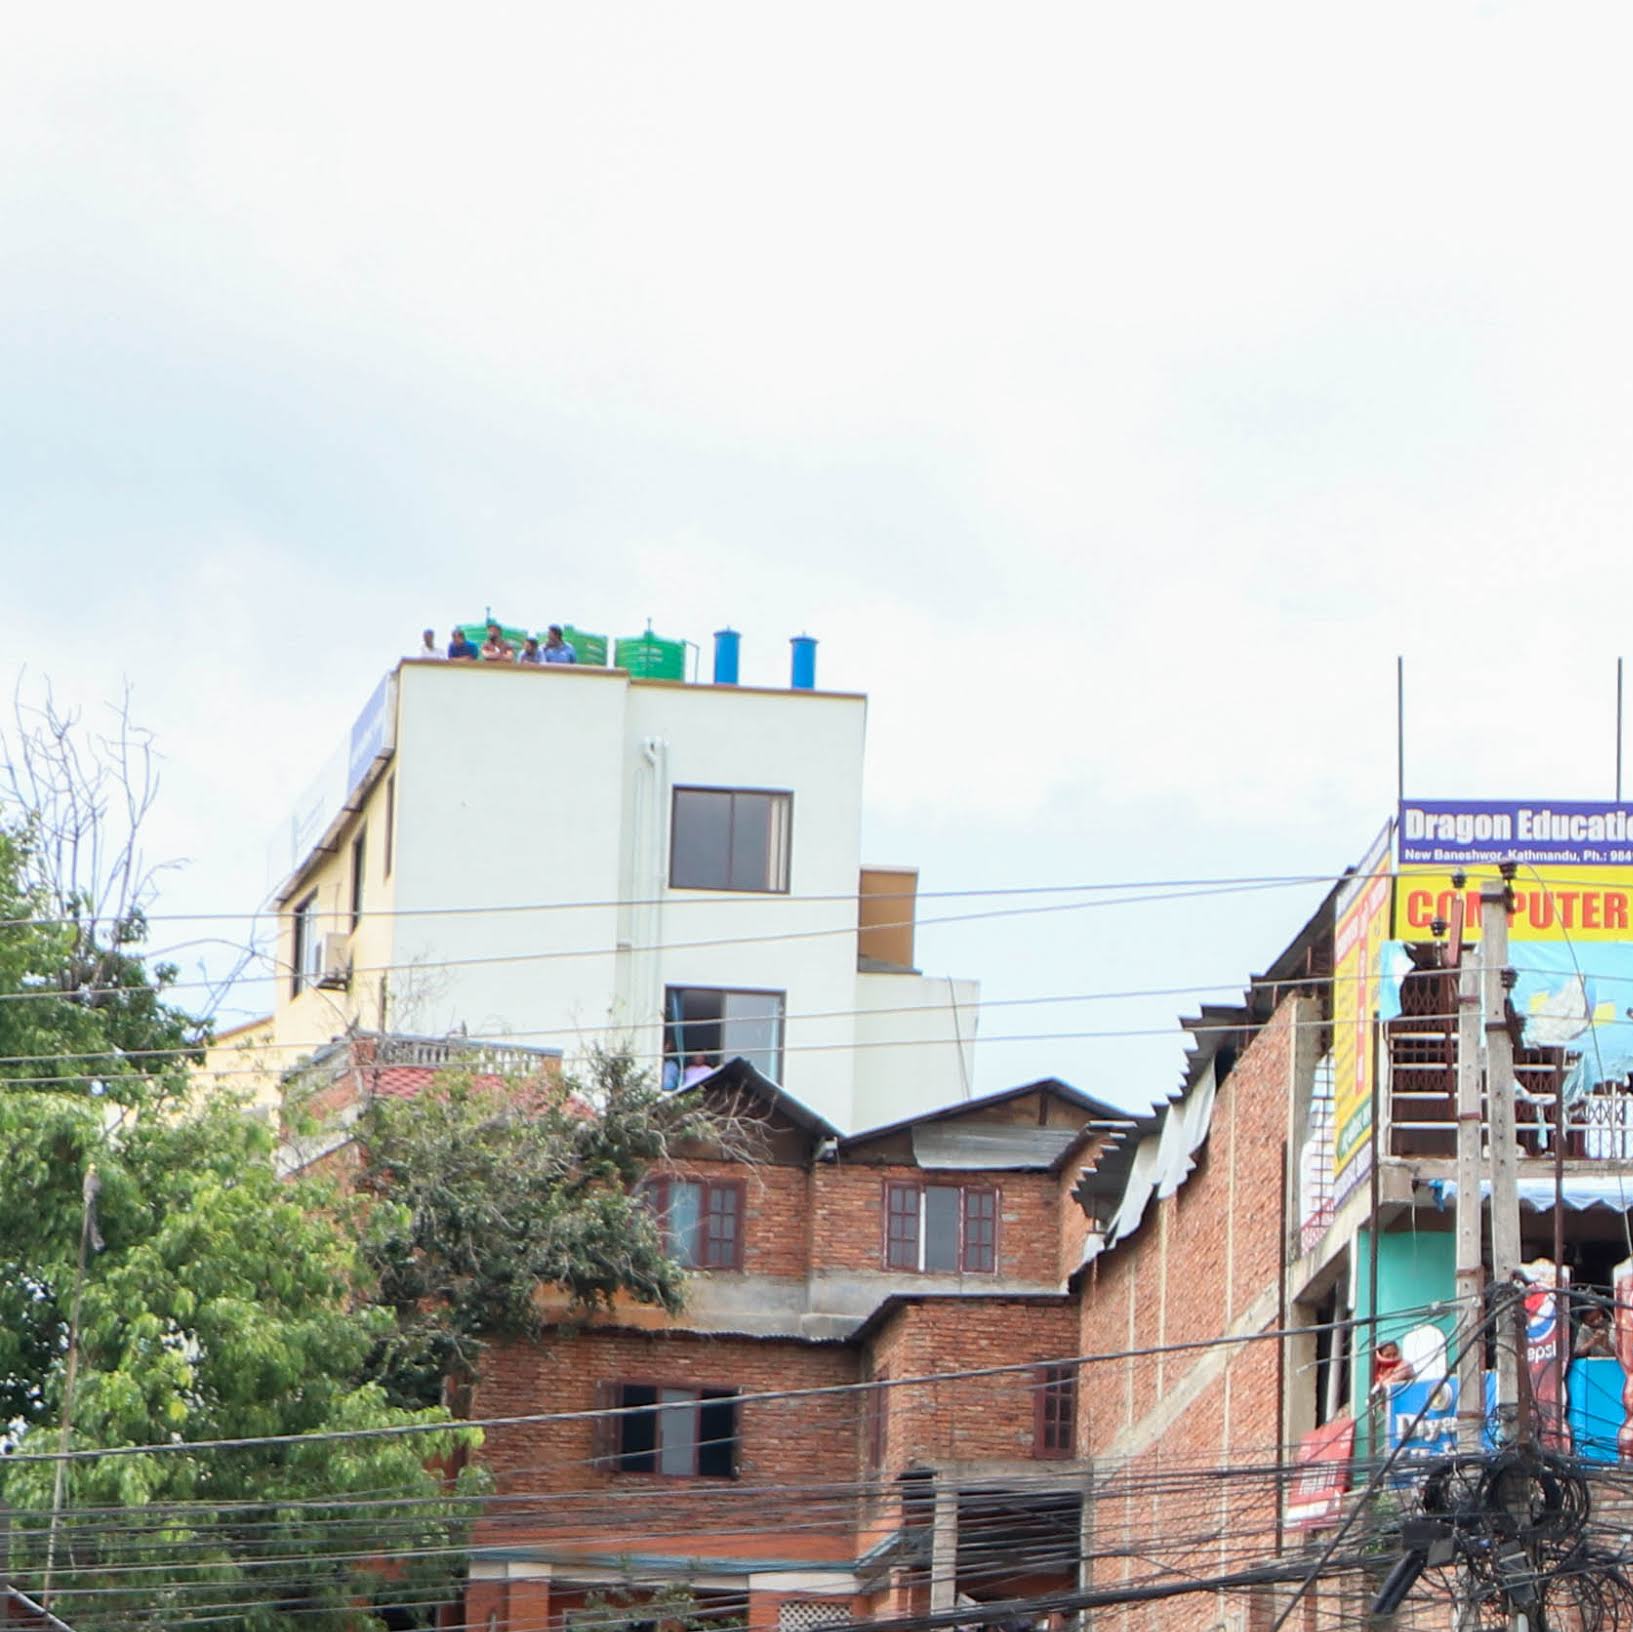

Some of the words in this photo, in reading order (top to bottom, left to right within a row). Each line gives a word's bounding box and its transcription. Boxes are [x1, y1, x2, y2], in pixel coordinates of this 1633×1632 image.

[1405, 809, 1512, 843] Dragon
[1405, 849, 1431, 860] New
[1526, 1341, 1557, 1363] epsi
